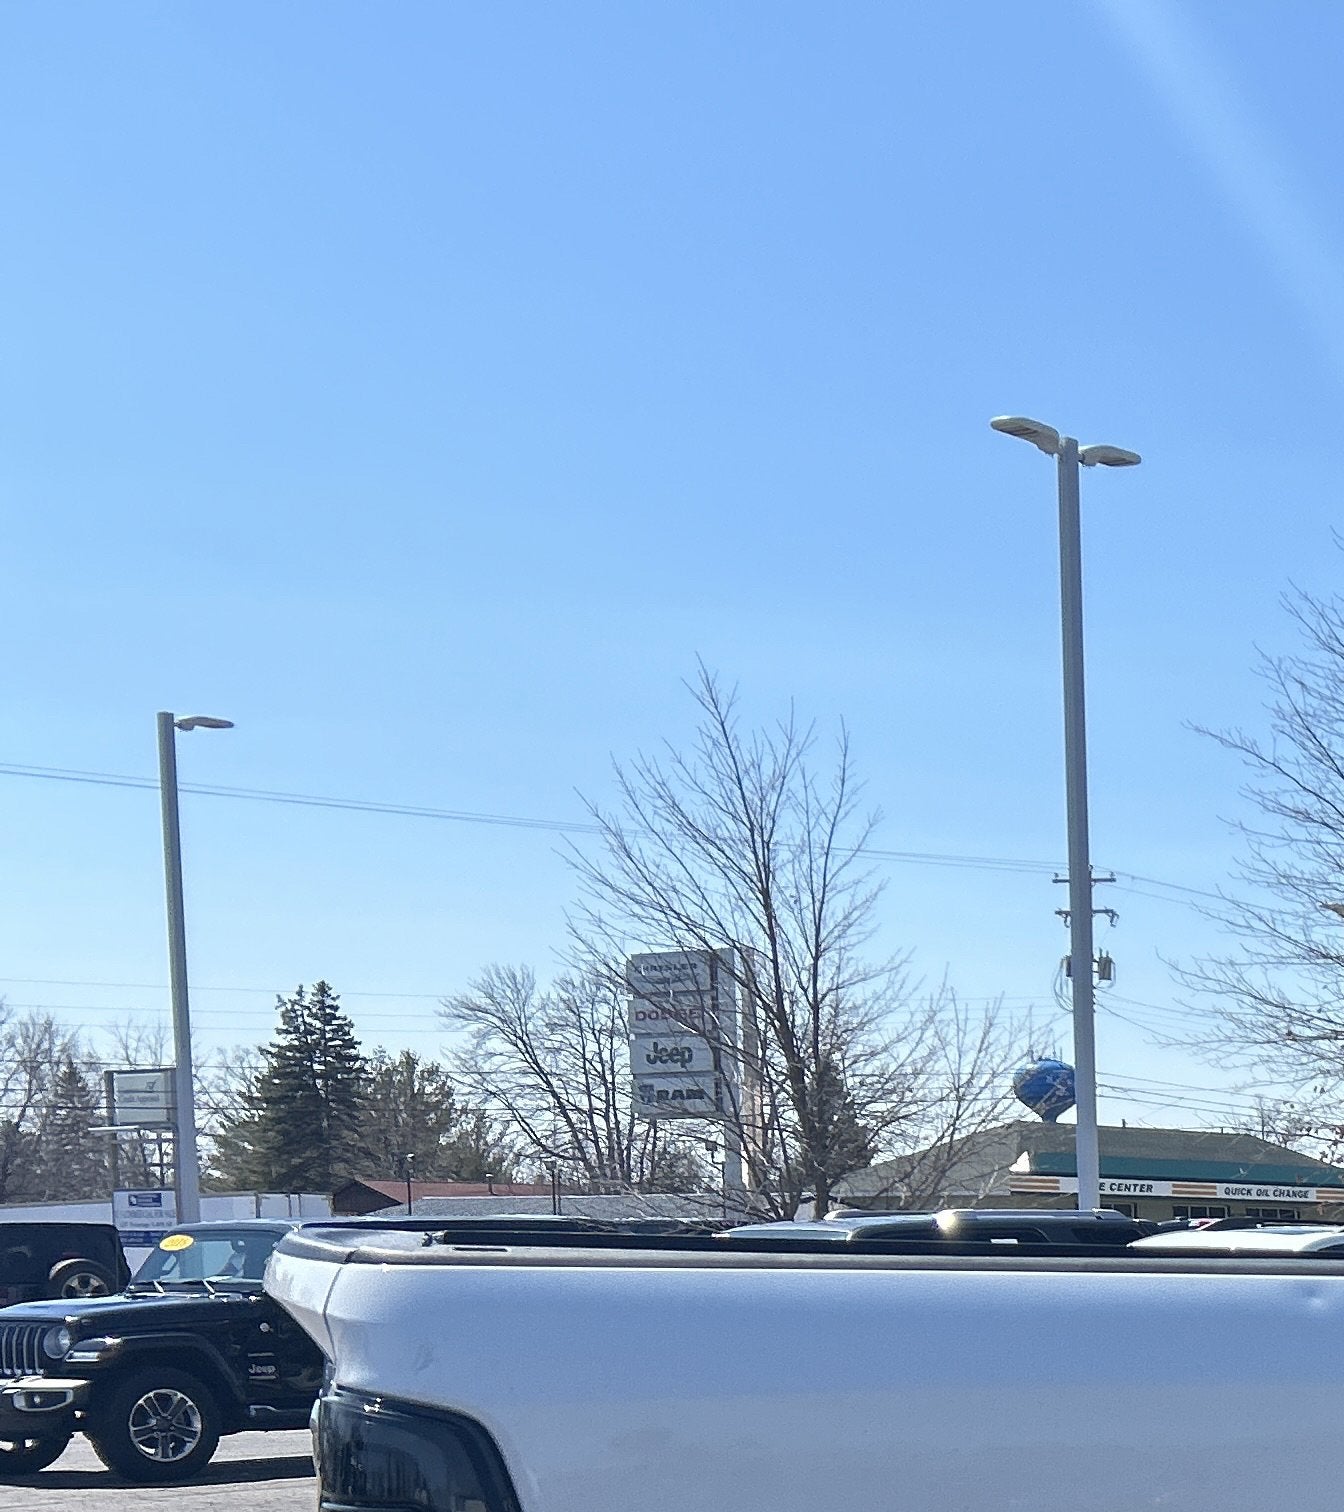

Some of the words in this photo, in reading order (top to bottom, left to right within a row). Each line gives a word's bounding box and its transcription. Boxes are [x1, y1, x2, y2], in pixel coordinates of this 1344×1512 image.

[646, 1041, 692, 1069] Jeep
[656, 1089, 705, 1100] RAM
[1109, 1183, 1153, 1193] CENTER
[1224, 1187, 1253, 1197] QUICK
[1256, 1188, 1271, 1198] OIL
[1272, 1188, 1310, 1199] CHANGE
[248, 1363, 277, 1374] Jeep
